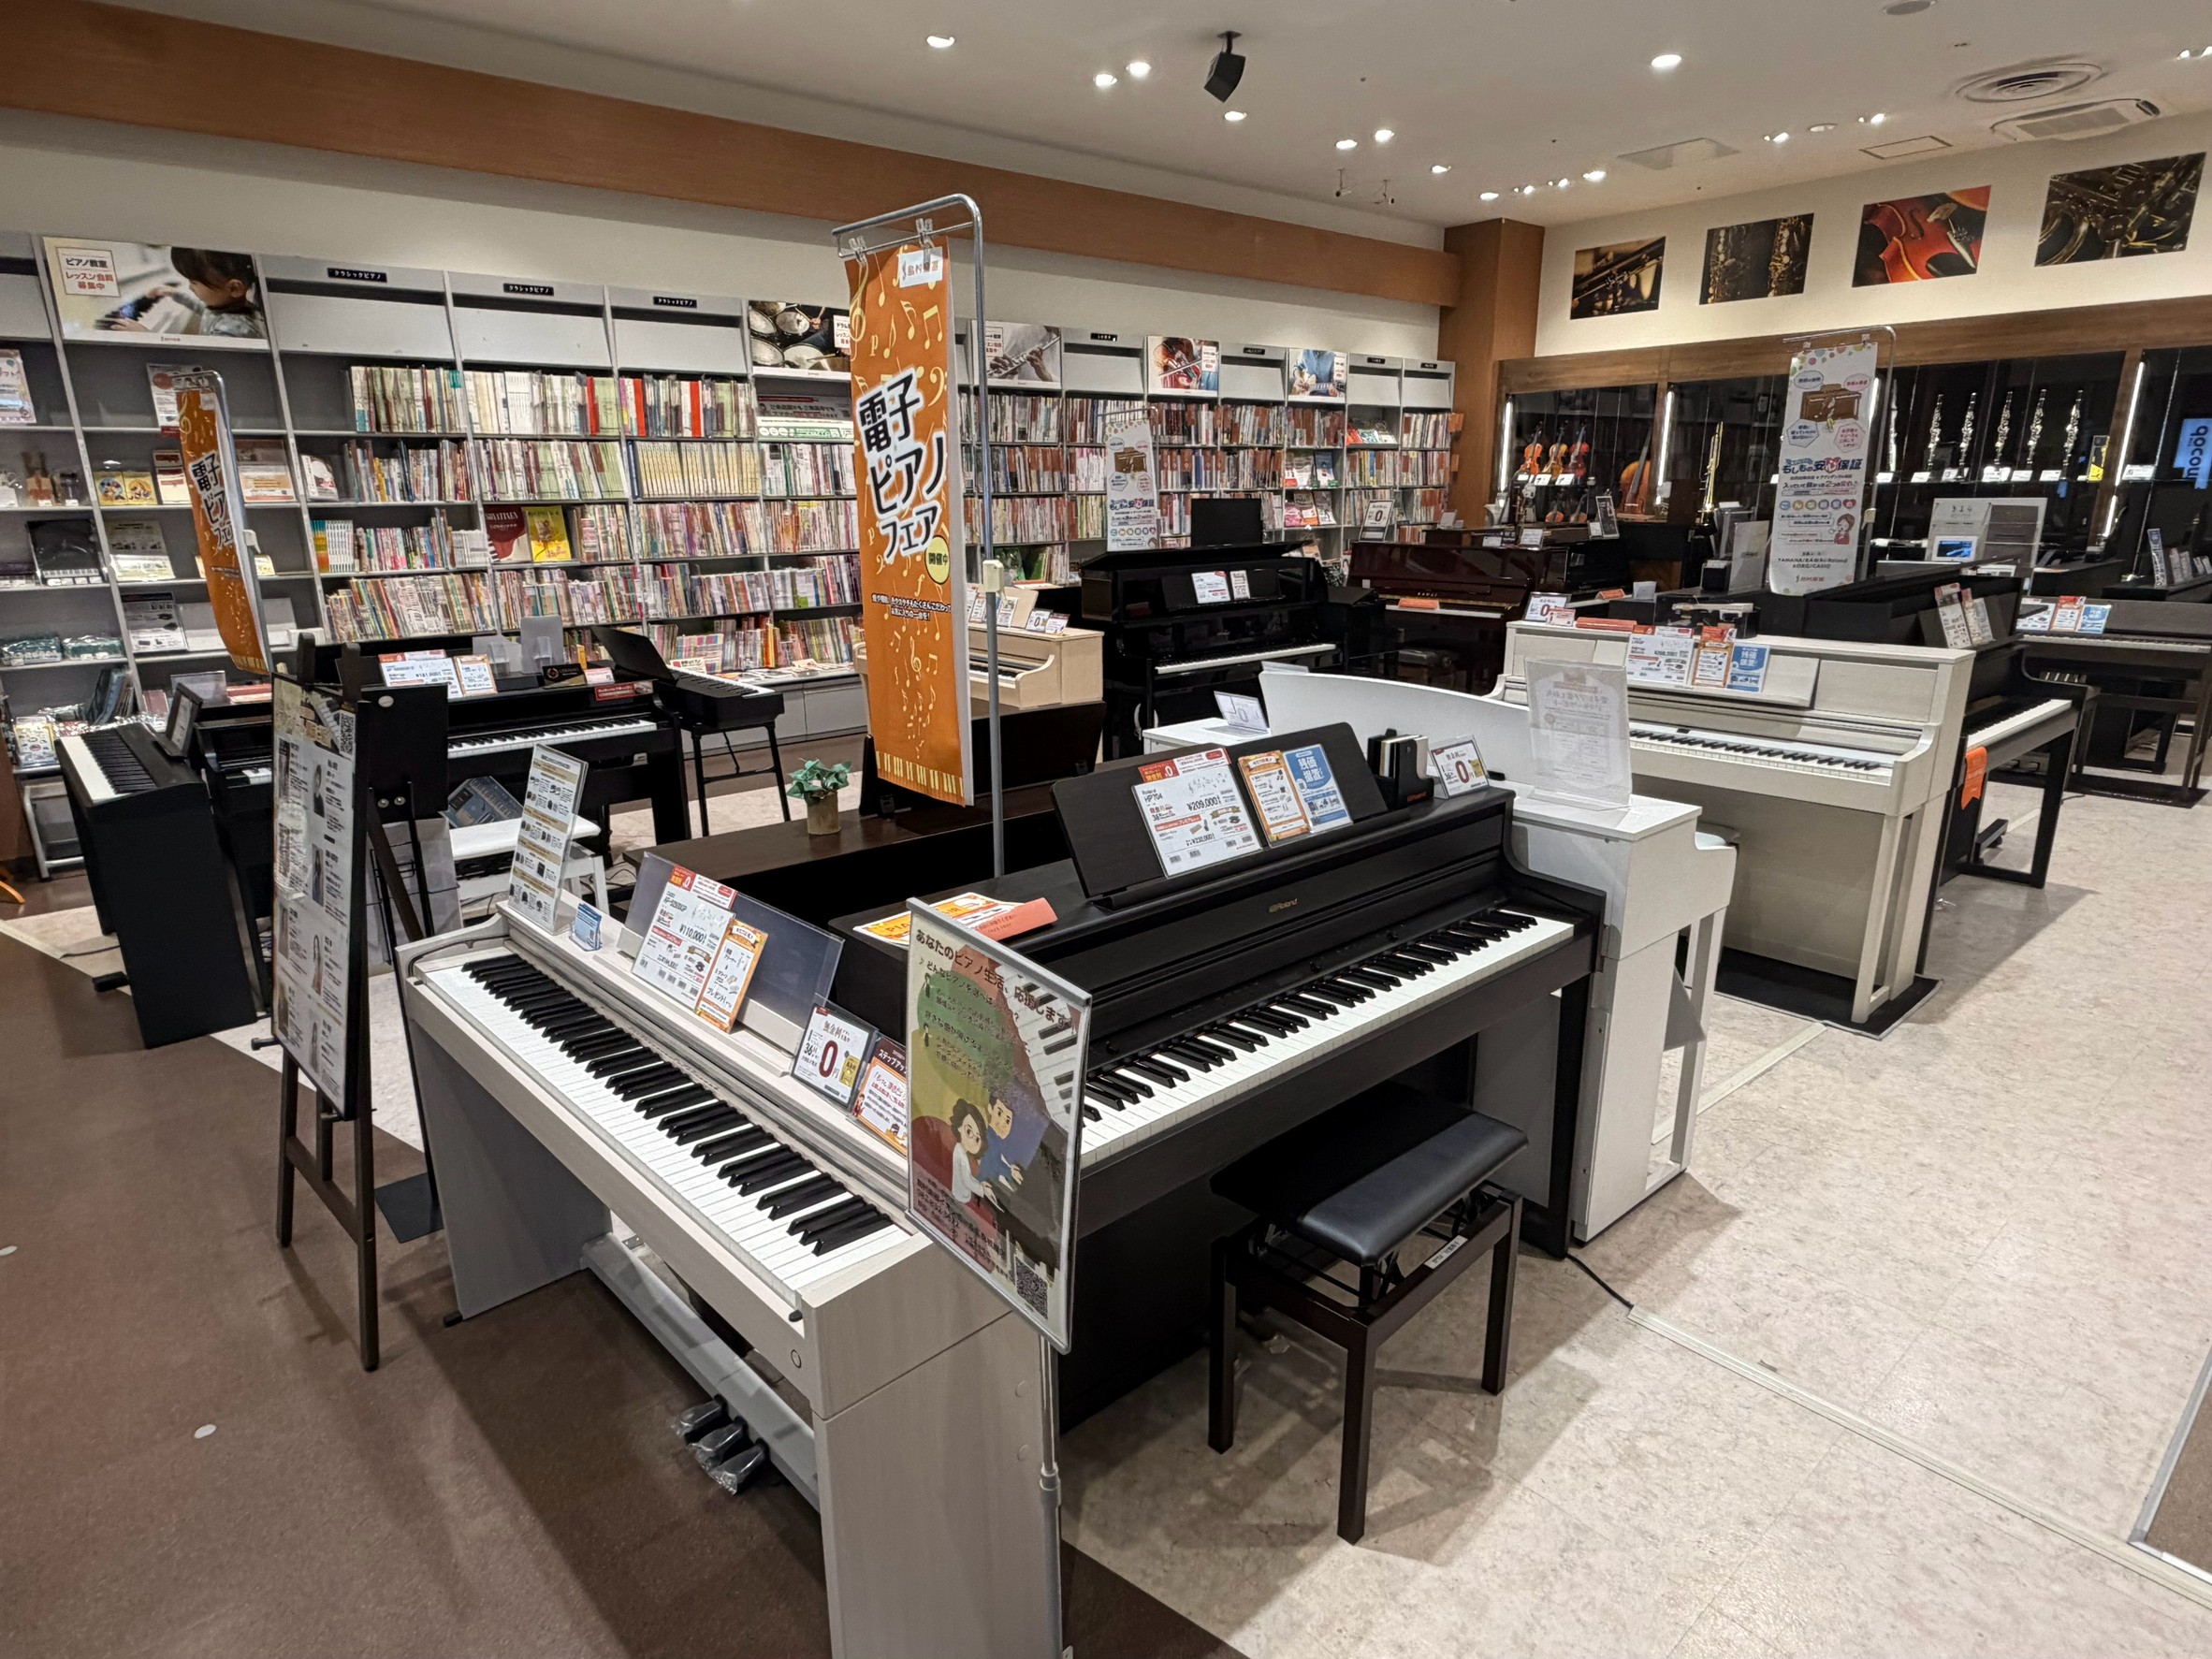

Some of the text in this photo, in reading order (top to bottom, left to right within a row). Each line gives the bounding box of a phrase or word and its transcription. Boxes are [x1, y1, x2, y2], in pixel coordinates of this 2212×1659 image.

[859, 373, 921, 453] 電子
[870, 436, 944, 515] ピアノ
[881, 506, 939, 560] フェア
[1455, 761, 1469, 783] 0
[819, 1040, 839, 1078] 0
[878, 1049, 907, 1074] ステップアッ
